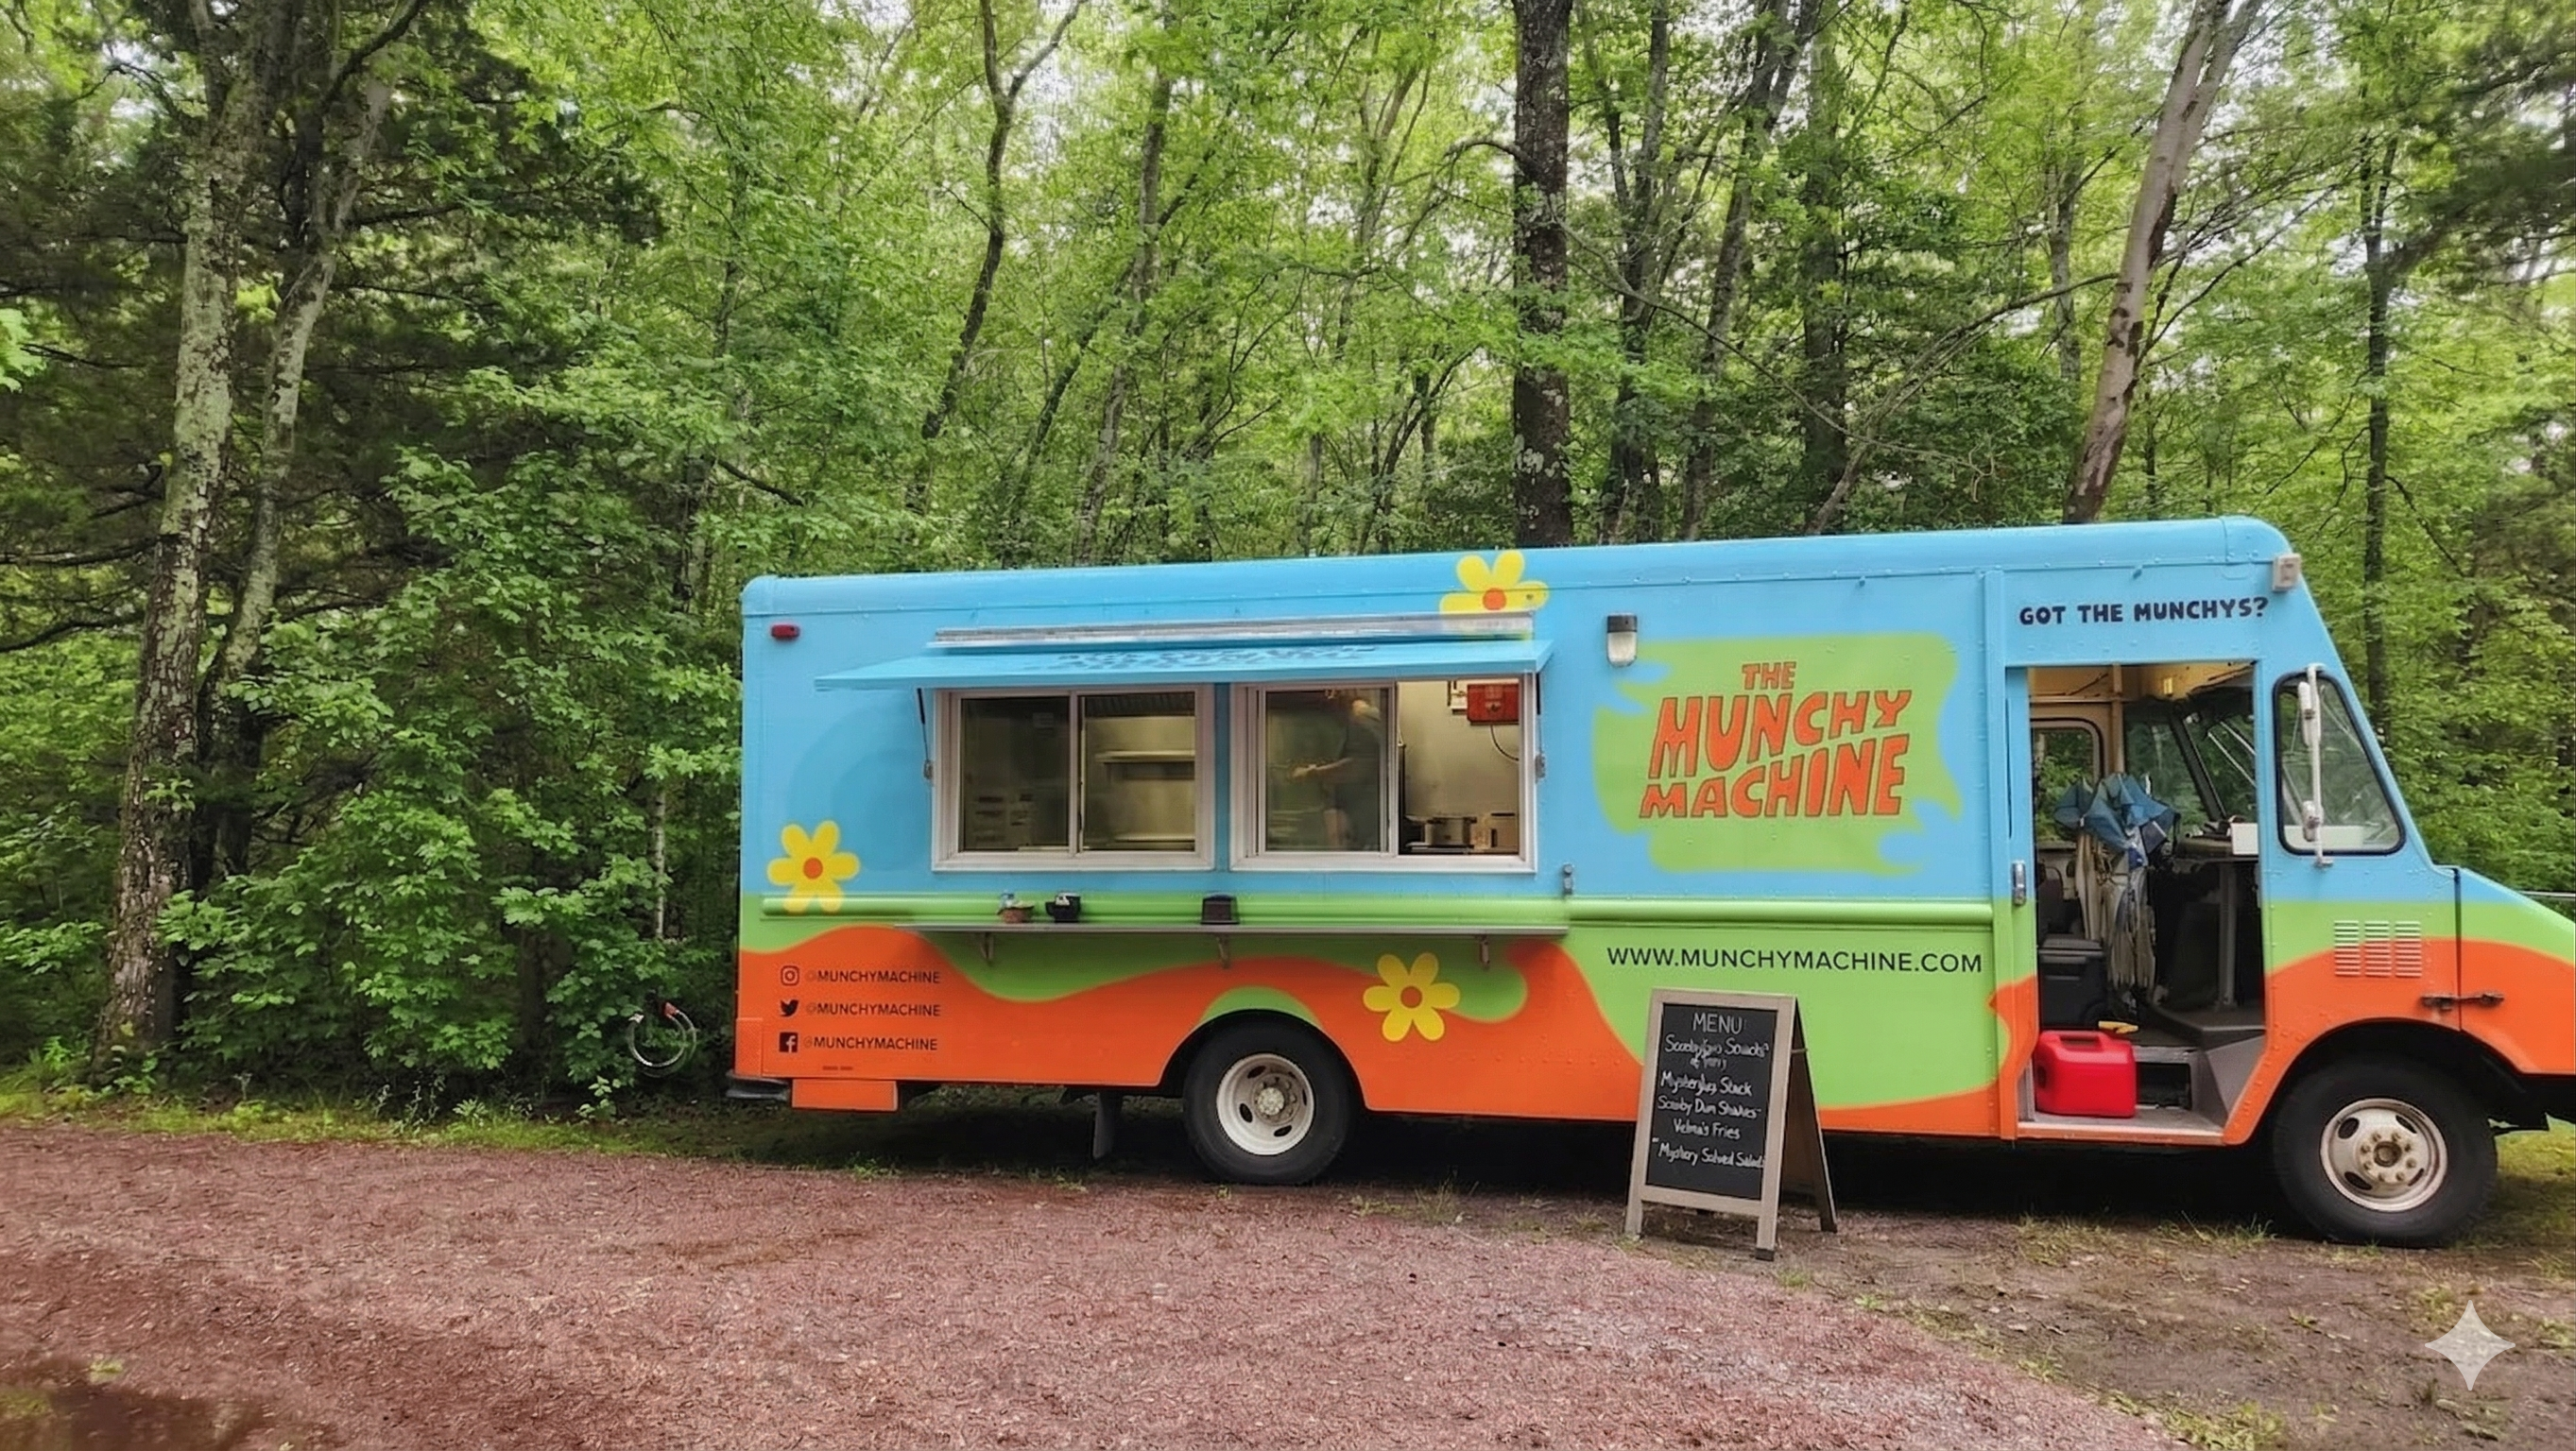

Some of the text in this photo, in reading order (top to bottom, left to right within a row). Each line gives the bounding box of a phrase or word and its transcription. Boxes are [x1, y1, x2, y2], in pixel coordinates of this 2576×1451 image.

[2019, 596, 2268, 625] GOT THE MUNCHYS?
[1742, 661, 1796, 691] THE
[1648, 690, 1913, 780] MUNCHY
[1639, 733, 1910, 818] MACHINE
[1606, 947, 1983, 973] WWW.MUNCHYMACHINE.COM
[1692, 1012, 1743, 1035] MENU
[1711, 1122, 1741, 1140] Fries
